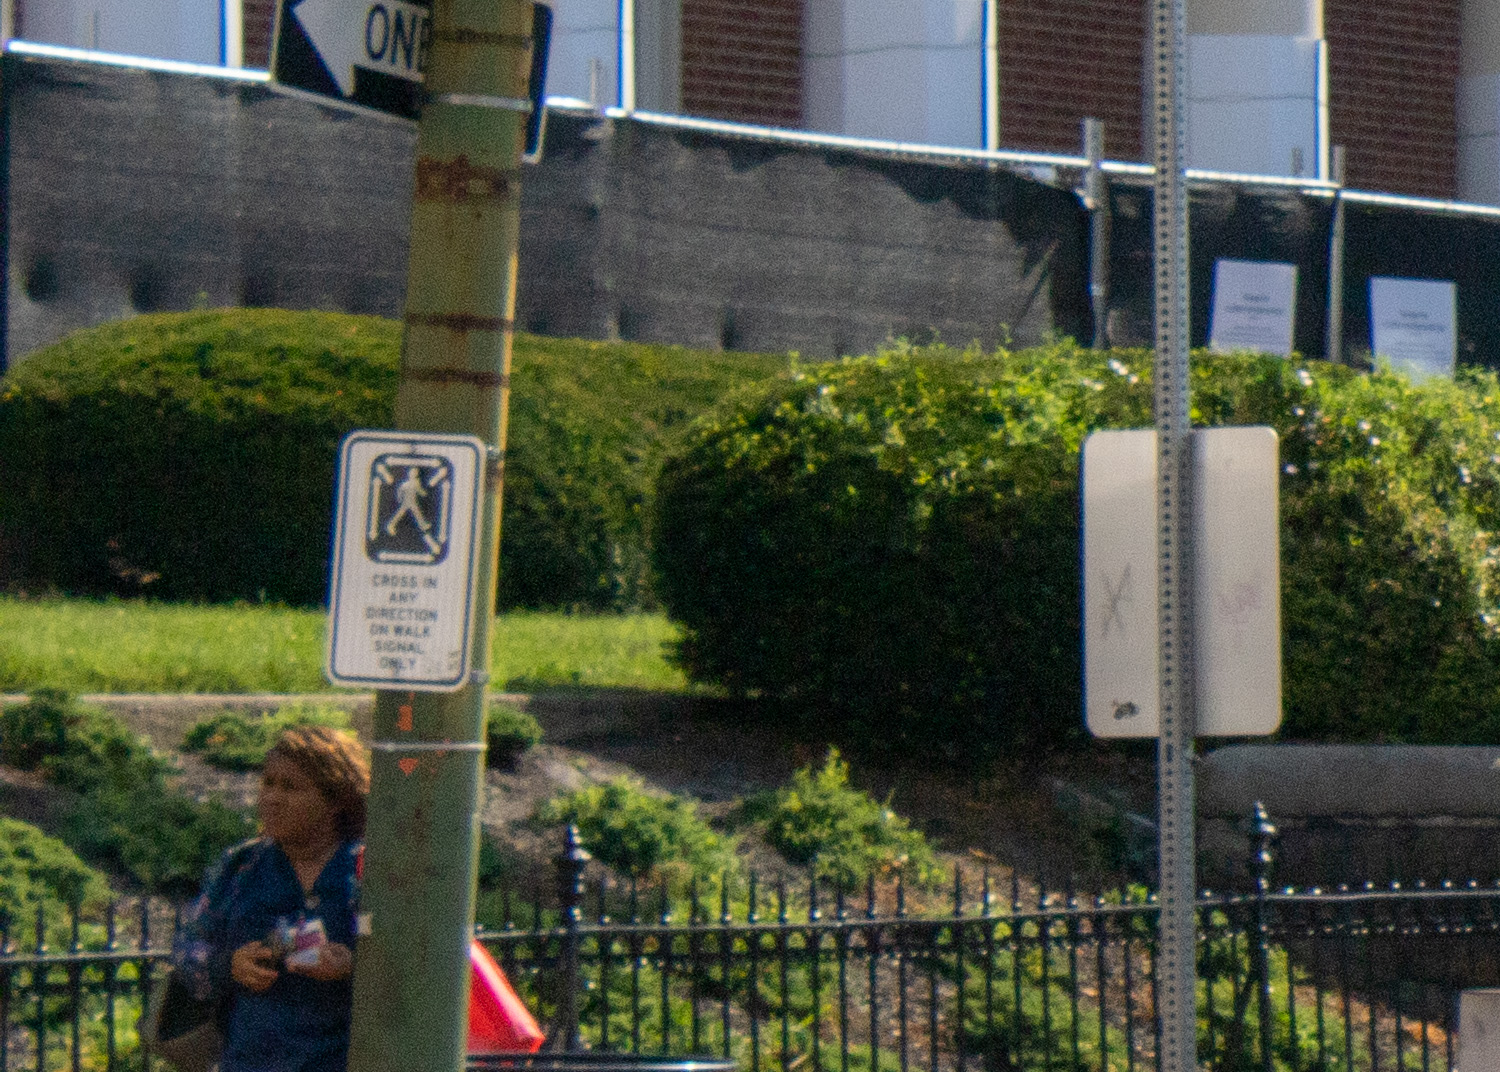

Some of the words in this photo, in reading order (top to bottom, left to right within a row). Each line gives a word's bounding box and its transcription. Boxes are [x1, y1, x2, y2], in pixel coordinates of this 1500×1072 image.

[373, 573, 418, 589] CROSS
[423, 576, 438, 589] IN
[389, 591, 418, 603] ANY
[365, 606, 438, 622] DIRECTION
[370, 624, 388, 636] ON
[393, 625, 430, 638] WALK
[375, 640, 424, 654] SIGNAL
